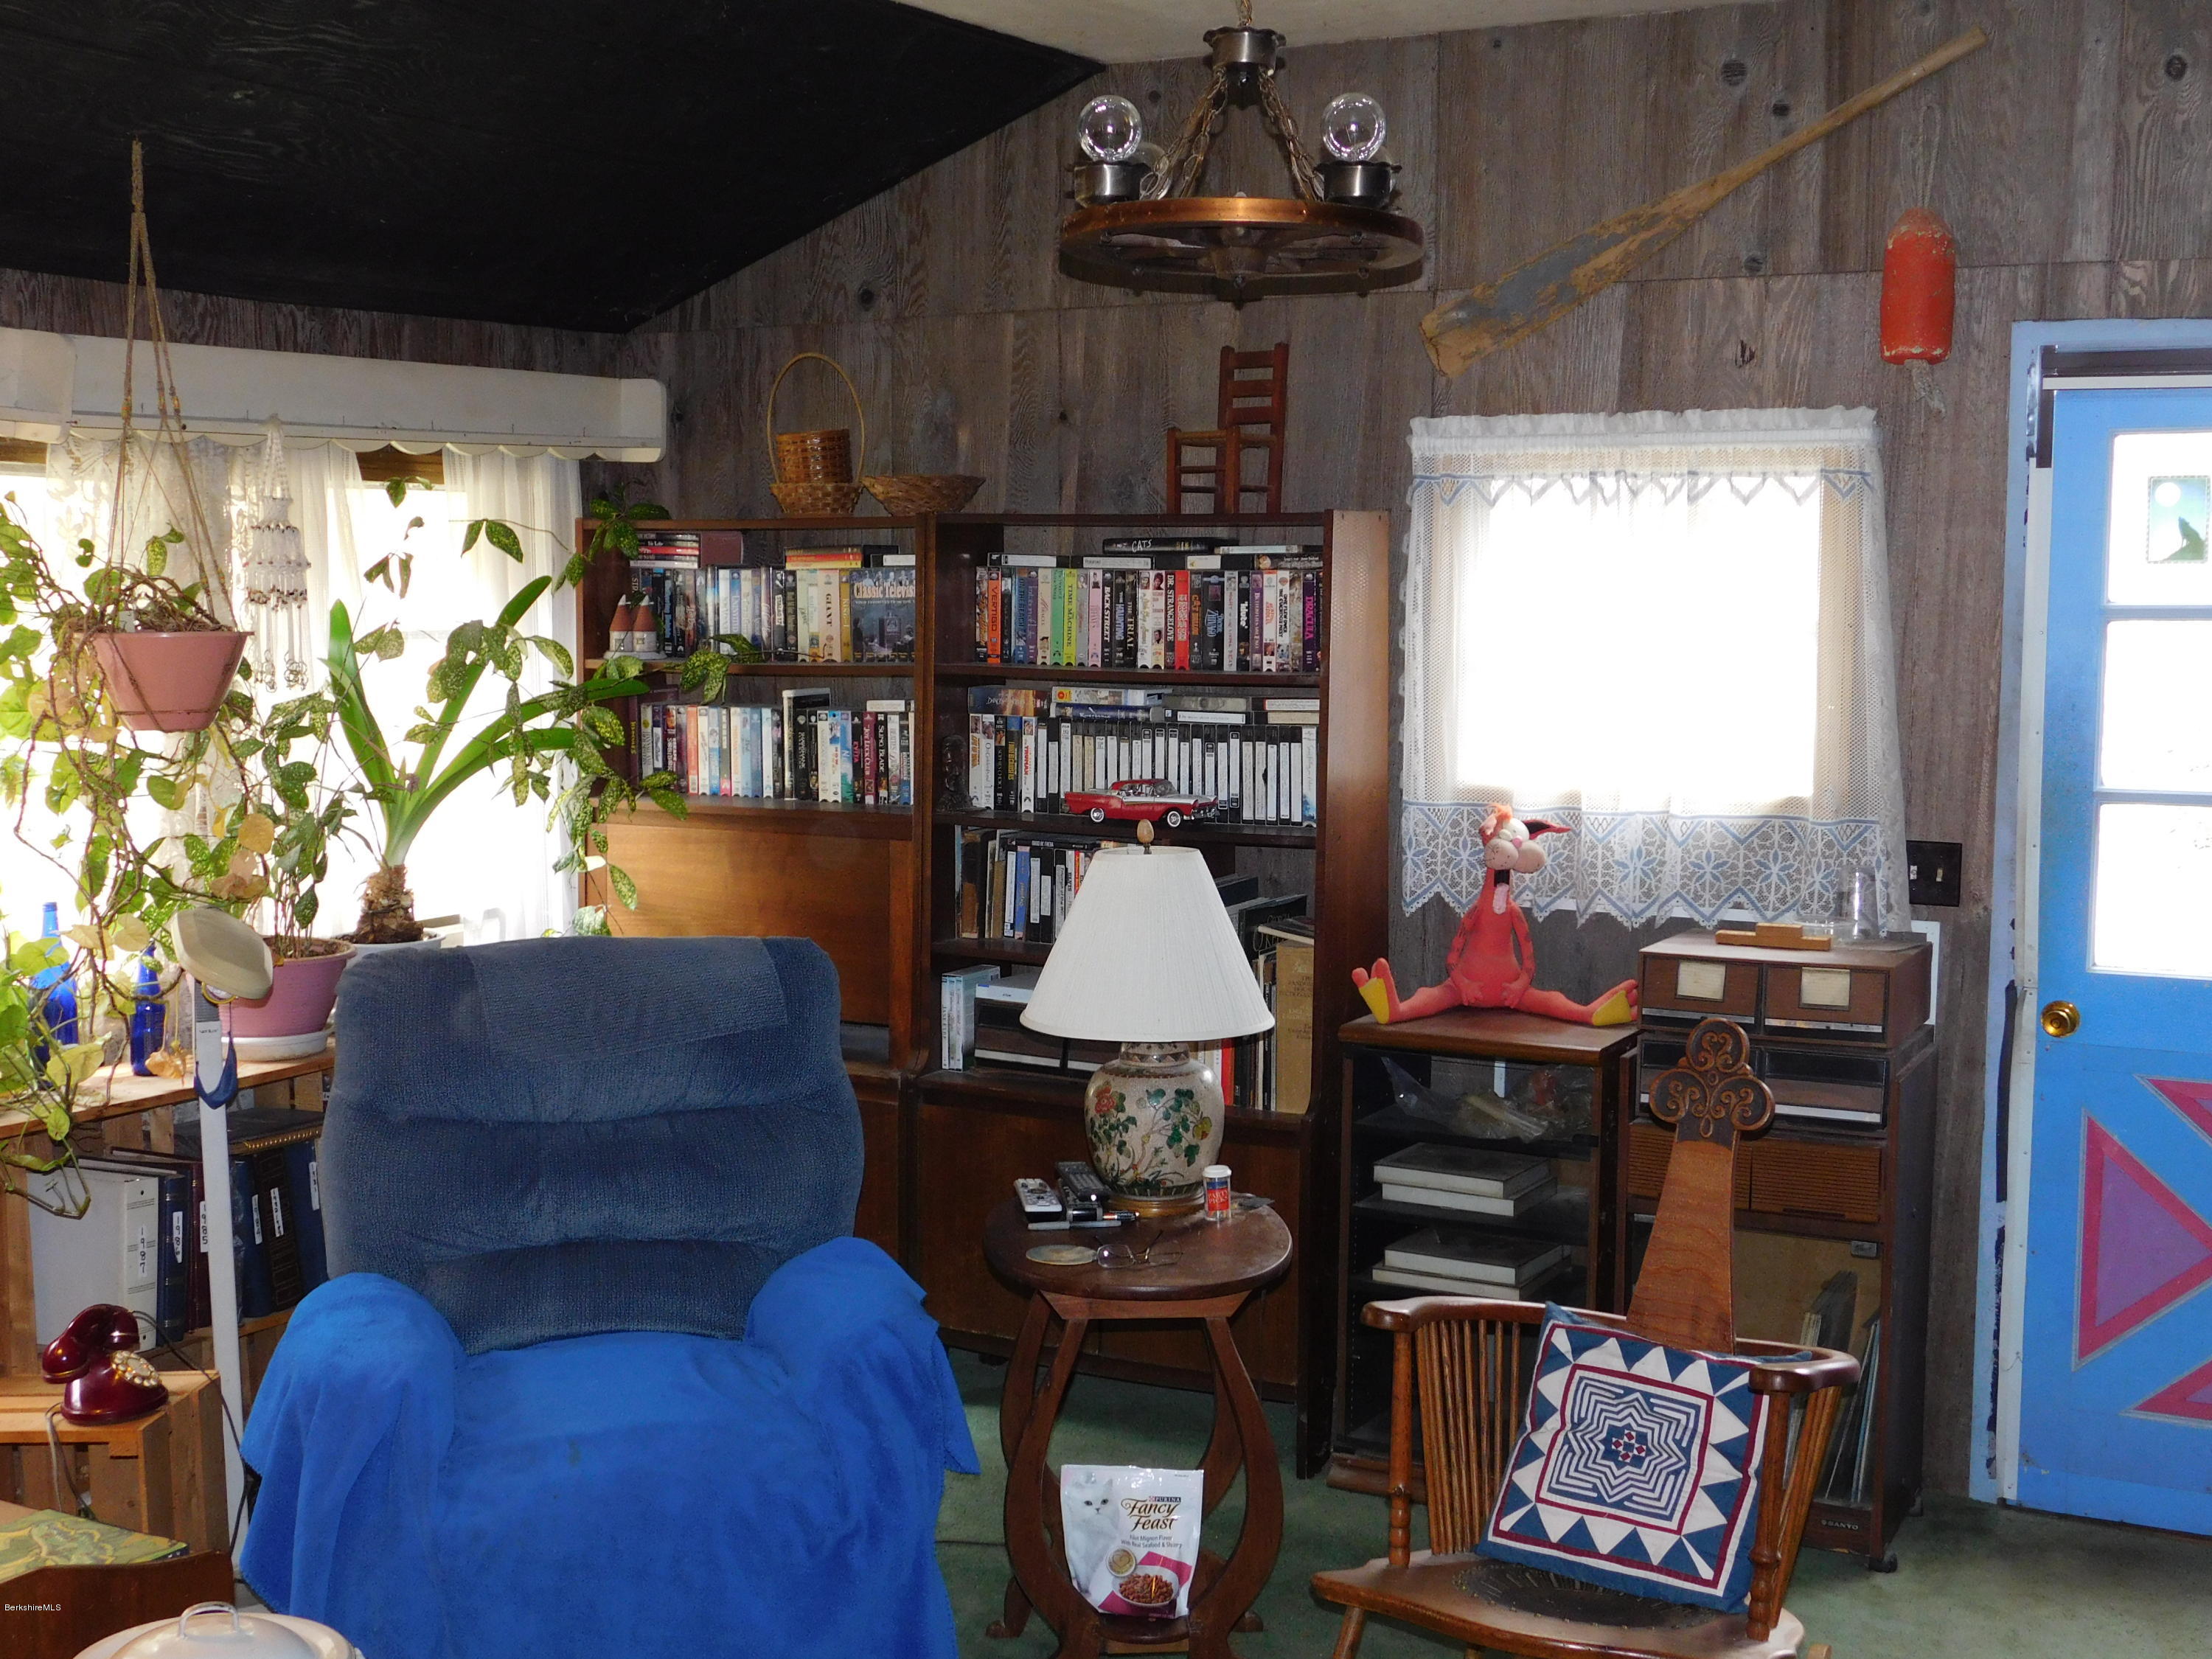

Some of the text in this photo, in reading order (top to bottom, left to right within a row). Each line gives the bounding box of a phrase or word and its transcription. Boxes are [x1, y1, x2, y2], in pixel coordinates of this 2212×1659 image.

[1131, 538, 1152, 553] CATS
[854, 581, 883, 598] Classic
[1018, 579, 1025, 587] ON
[1116, 604, 1124, 640] HAUNTING
[1304, 596, 1314, 640] DRACULA
[1121, 1498, 1180, 1518] Fancy
[1130, 1514, 1179, 1531] Feast
[1827, 1520, 1859, 1530] SANYO
